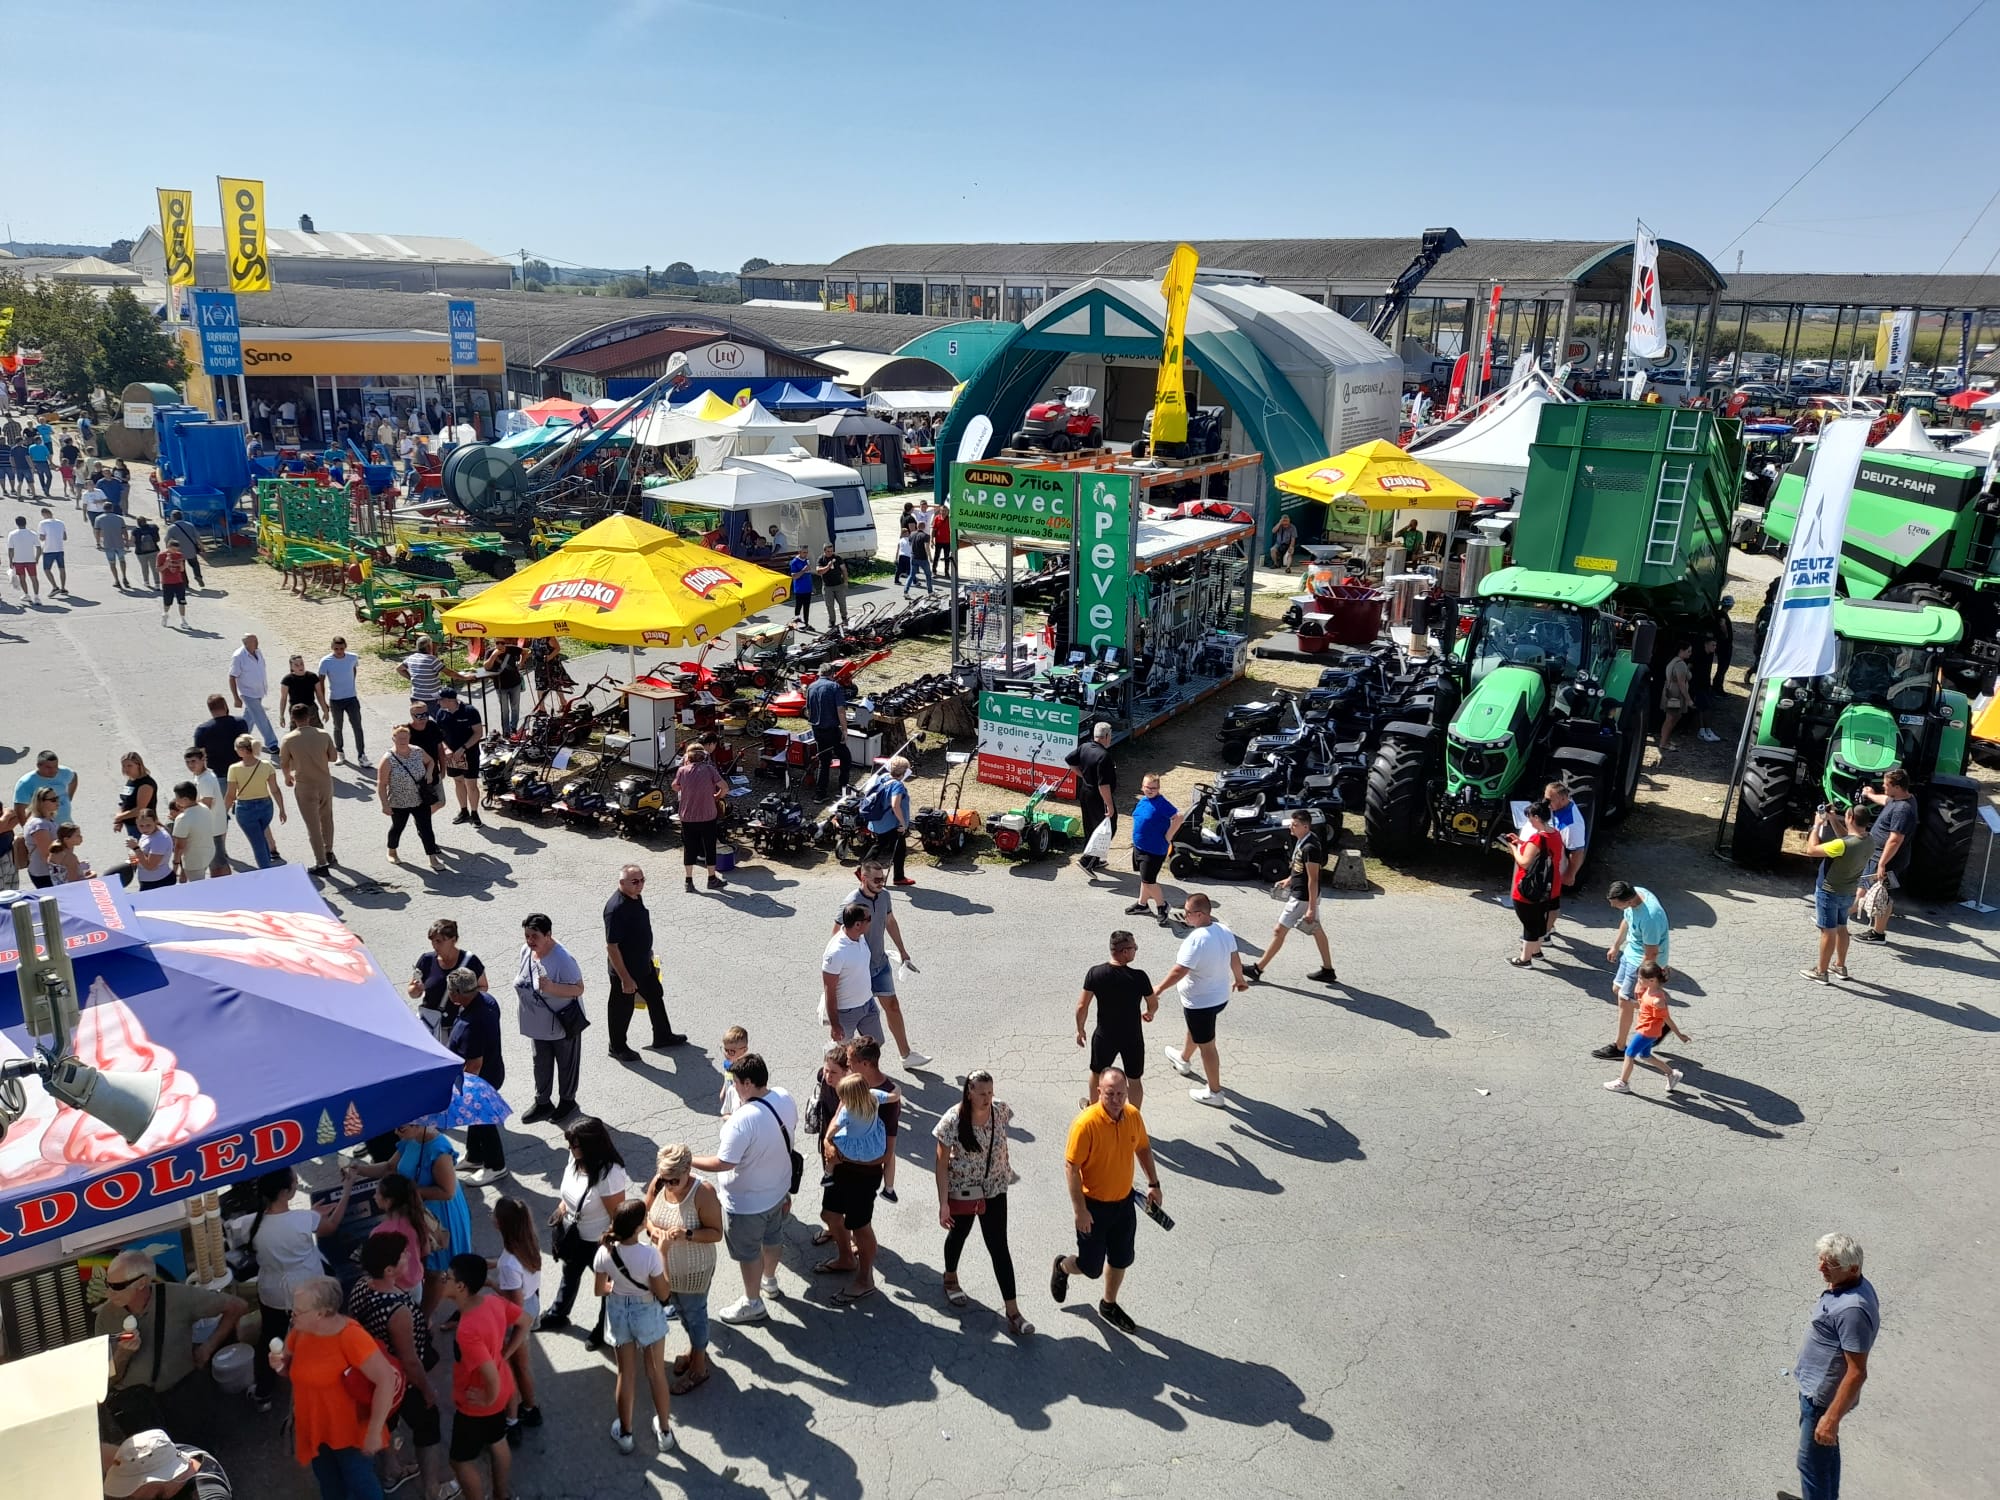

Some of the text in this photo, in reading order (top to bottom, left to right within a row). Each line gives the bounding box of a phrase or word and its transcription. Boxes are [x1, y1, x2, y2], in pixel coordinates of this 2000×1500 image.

[167, 198, 193, 278] Sano
[233, 189, 266, 281] Sano
[244, 348, 292, 366] Sano
[950, 341, 957, 354] 5
[968, 471, 1063, 492] ALPINA STIGA
[1861, 469, 1936, 495] DEUTZ-FAHR
[959, 508, 1072, 529] SAJAMSKI POPUST do 40%
[1041, 528, 1053, 538] 36
[1790, 557, 1834, 572] DEUTZ
[539, 580, 616, 604] Ožujsko
[1010, 704, 1072, 725] PEVEC
[983, 721, 1074, 746] 33 godine sa Vama
[1006, 763, 1015, 772] 33
[1005, 774, 1021, 784] 33%
[0, 1119, 303, 1245] DOLED
